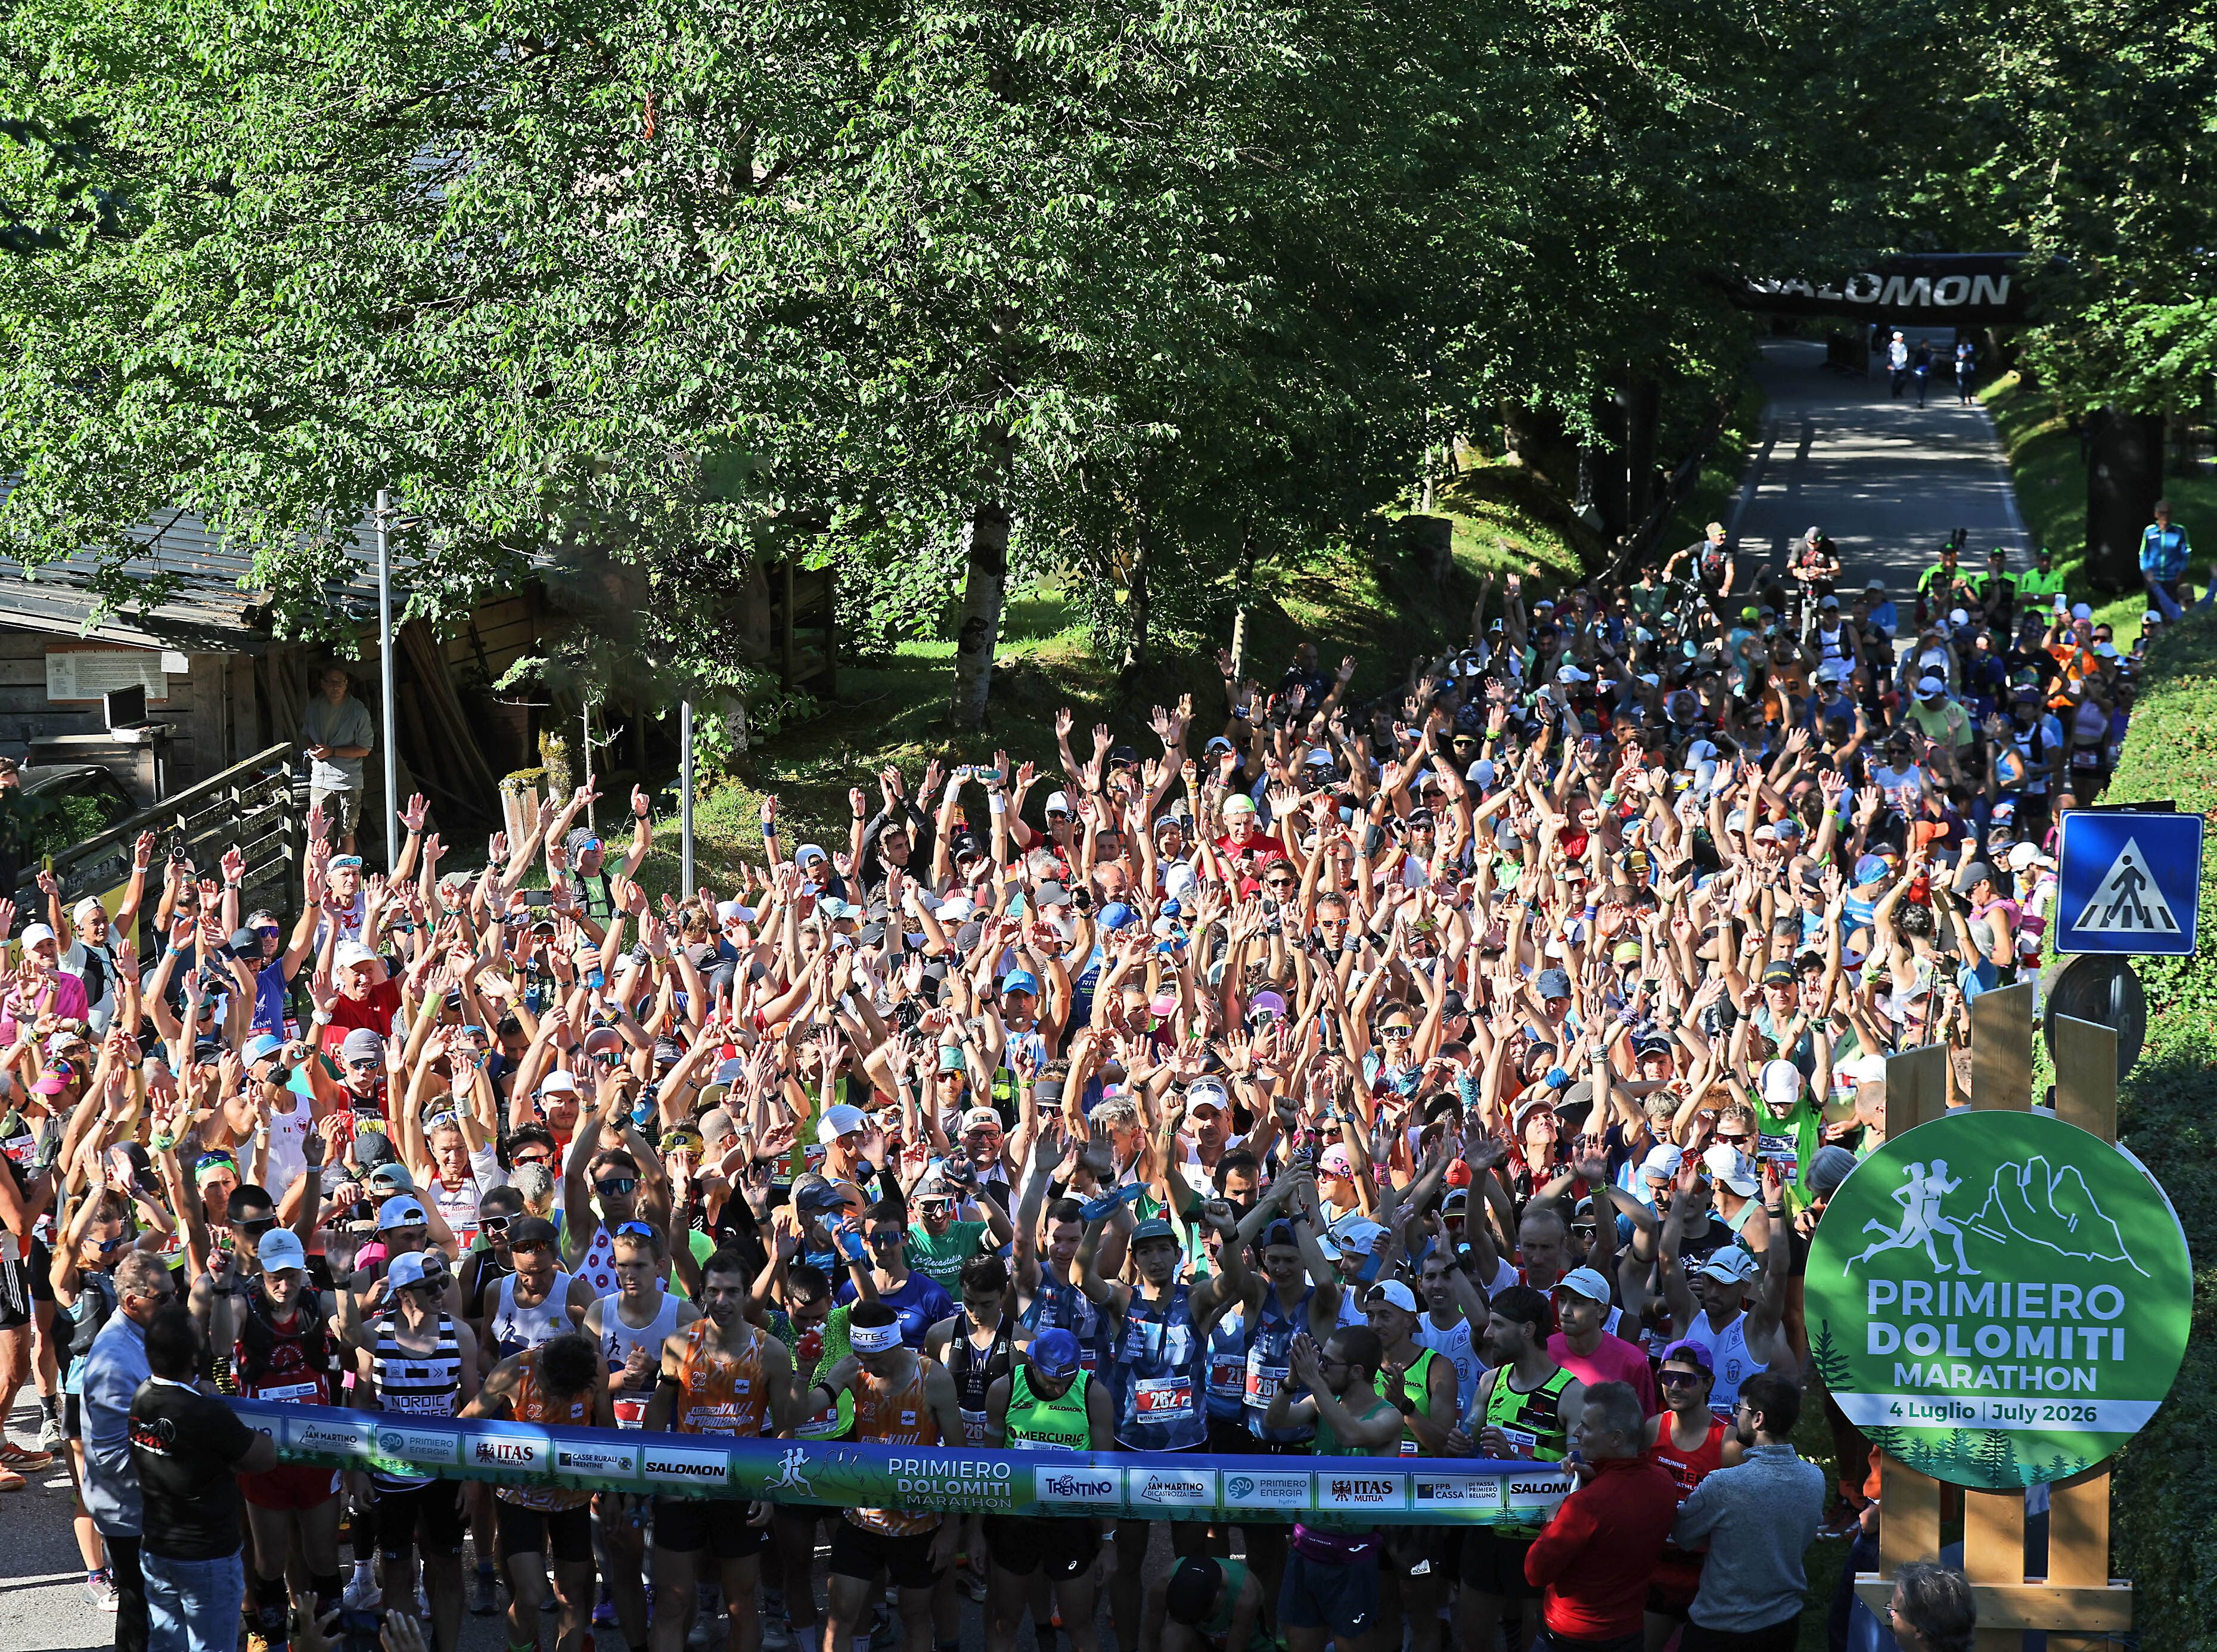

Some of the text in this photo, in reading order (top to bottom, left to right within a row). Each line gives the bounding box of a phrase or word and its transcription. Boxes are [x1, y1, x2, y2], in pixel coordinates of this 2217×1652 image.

[1868, 1279, 2125, 1320] PRIMIERO
[1867, 1322, 2124, 1361] DOLOMITI
[1893, 1362, 2096, 1391] MARATHON
[1256, 1378, 1278, 1398] 261
[1404, 1380, 1423, 1389] OMON
[391, 1395, 445, 1408] NORDIC
[1150, 1390, 1178, 1409] 262
[1048, 1405, 1083, 1413] SALOMON
[1889, 1402, 2097, 1425] 4 Luglio July 2026
[305, 1430, 358, 1443] SAN MARTINO
[410, 1437, 454, 1448] PRIMIERO
[1020, 1430, 1085, 1443] MERCURIO
[410, 1446, 449, 1456] ENERGIA
[496, 1444, 534, 1461] ITAS
[573, 1454, 617, 1463] CASSE RURALI
[1658, 1456, 1687, 1470] TRIRUNNIS
[645, 1462, 726, 1476] SALOMON
[888, 1458, 1011, 1480] PRIMIERO
[897, 1478, 1011, 1497] DOLOMITI
[1046, 1477, 1113, 1497] TRENTINO
[1148, 1482, 1204, 1491] SAN MARTINO
[1354, 1480, 1393, 1495] ITAS
[1510, 1483, 1571, 1494] SALOM
[906, 1494, 1012, 1508] MARATHON
